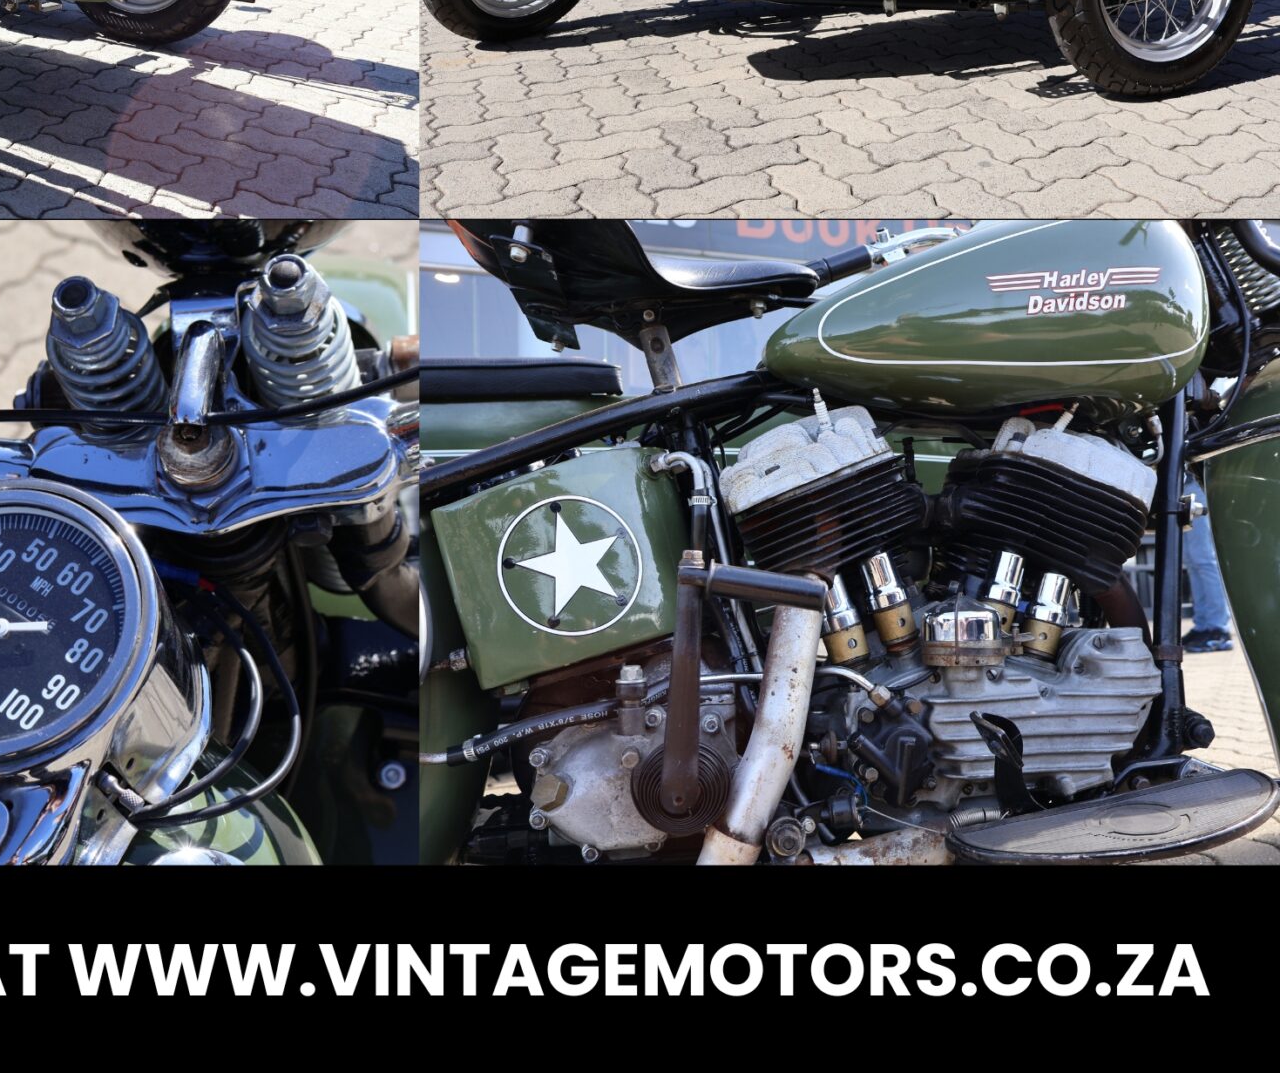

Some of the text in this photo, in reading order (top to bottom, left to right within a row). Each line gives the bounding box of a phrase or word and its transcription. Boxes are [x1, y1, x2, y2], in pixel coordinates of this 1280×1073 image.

[1042, 269, 1111, 292] Harley
[1027, 291, 1126, 316] Davidson
[21, 538, 59, 572] 50
[30, 576, 55, 598] MPH
[56, 562, 94, 595] 60
[70, 598, 109, 634] 70
[64, 638, 104, 674] 80
[41, 674, 81, 711] 90
[580, 709, 609, 721] HOSE
[475, 743, 490, 755] PSI
[493, 736, 509, 747] 200
